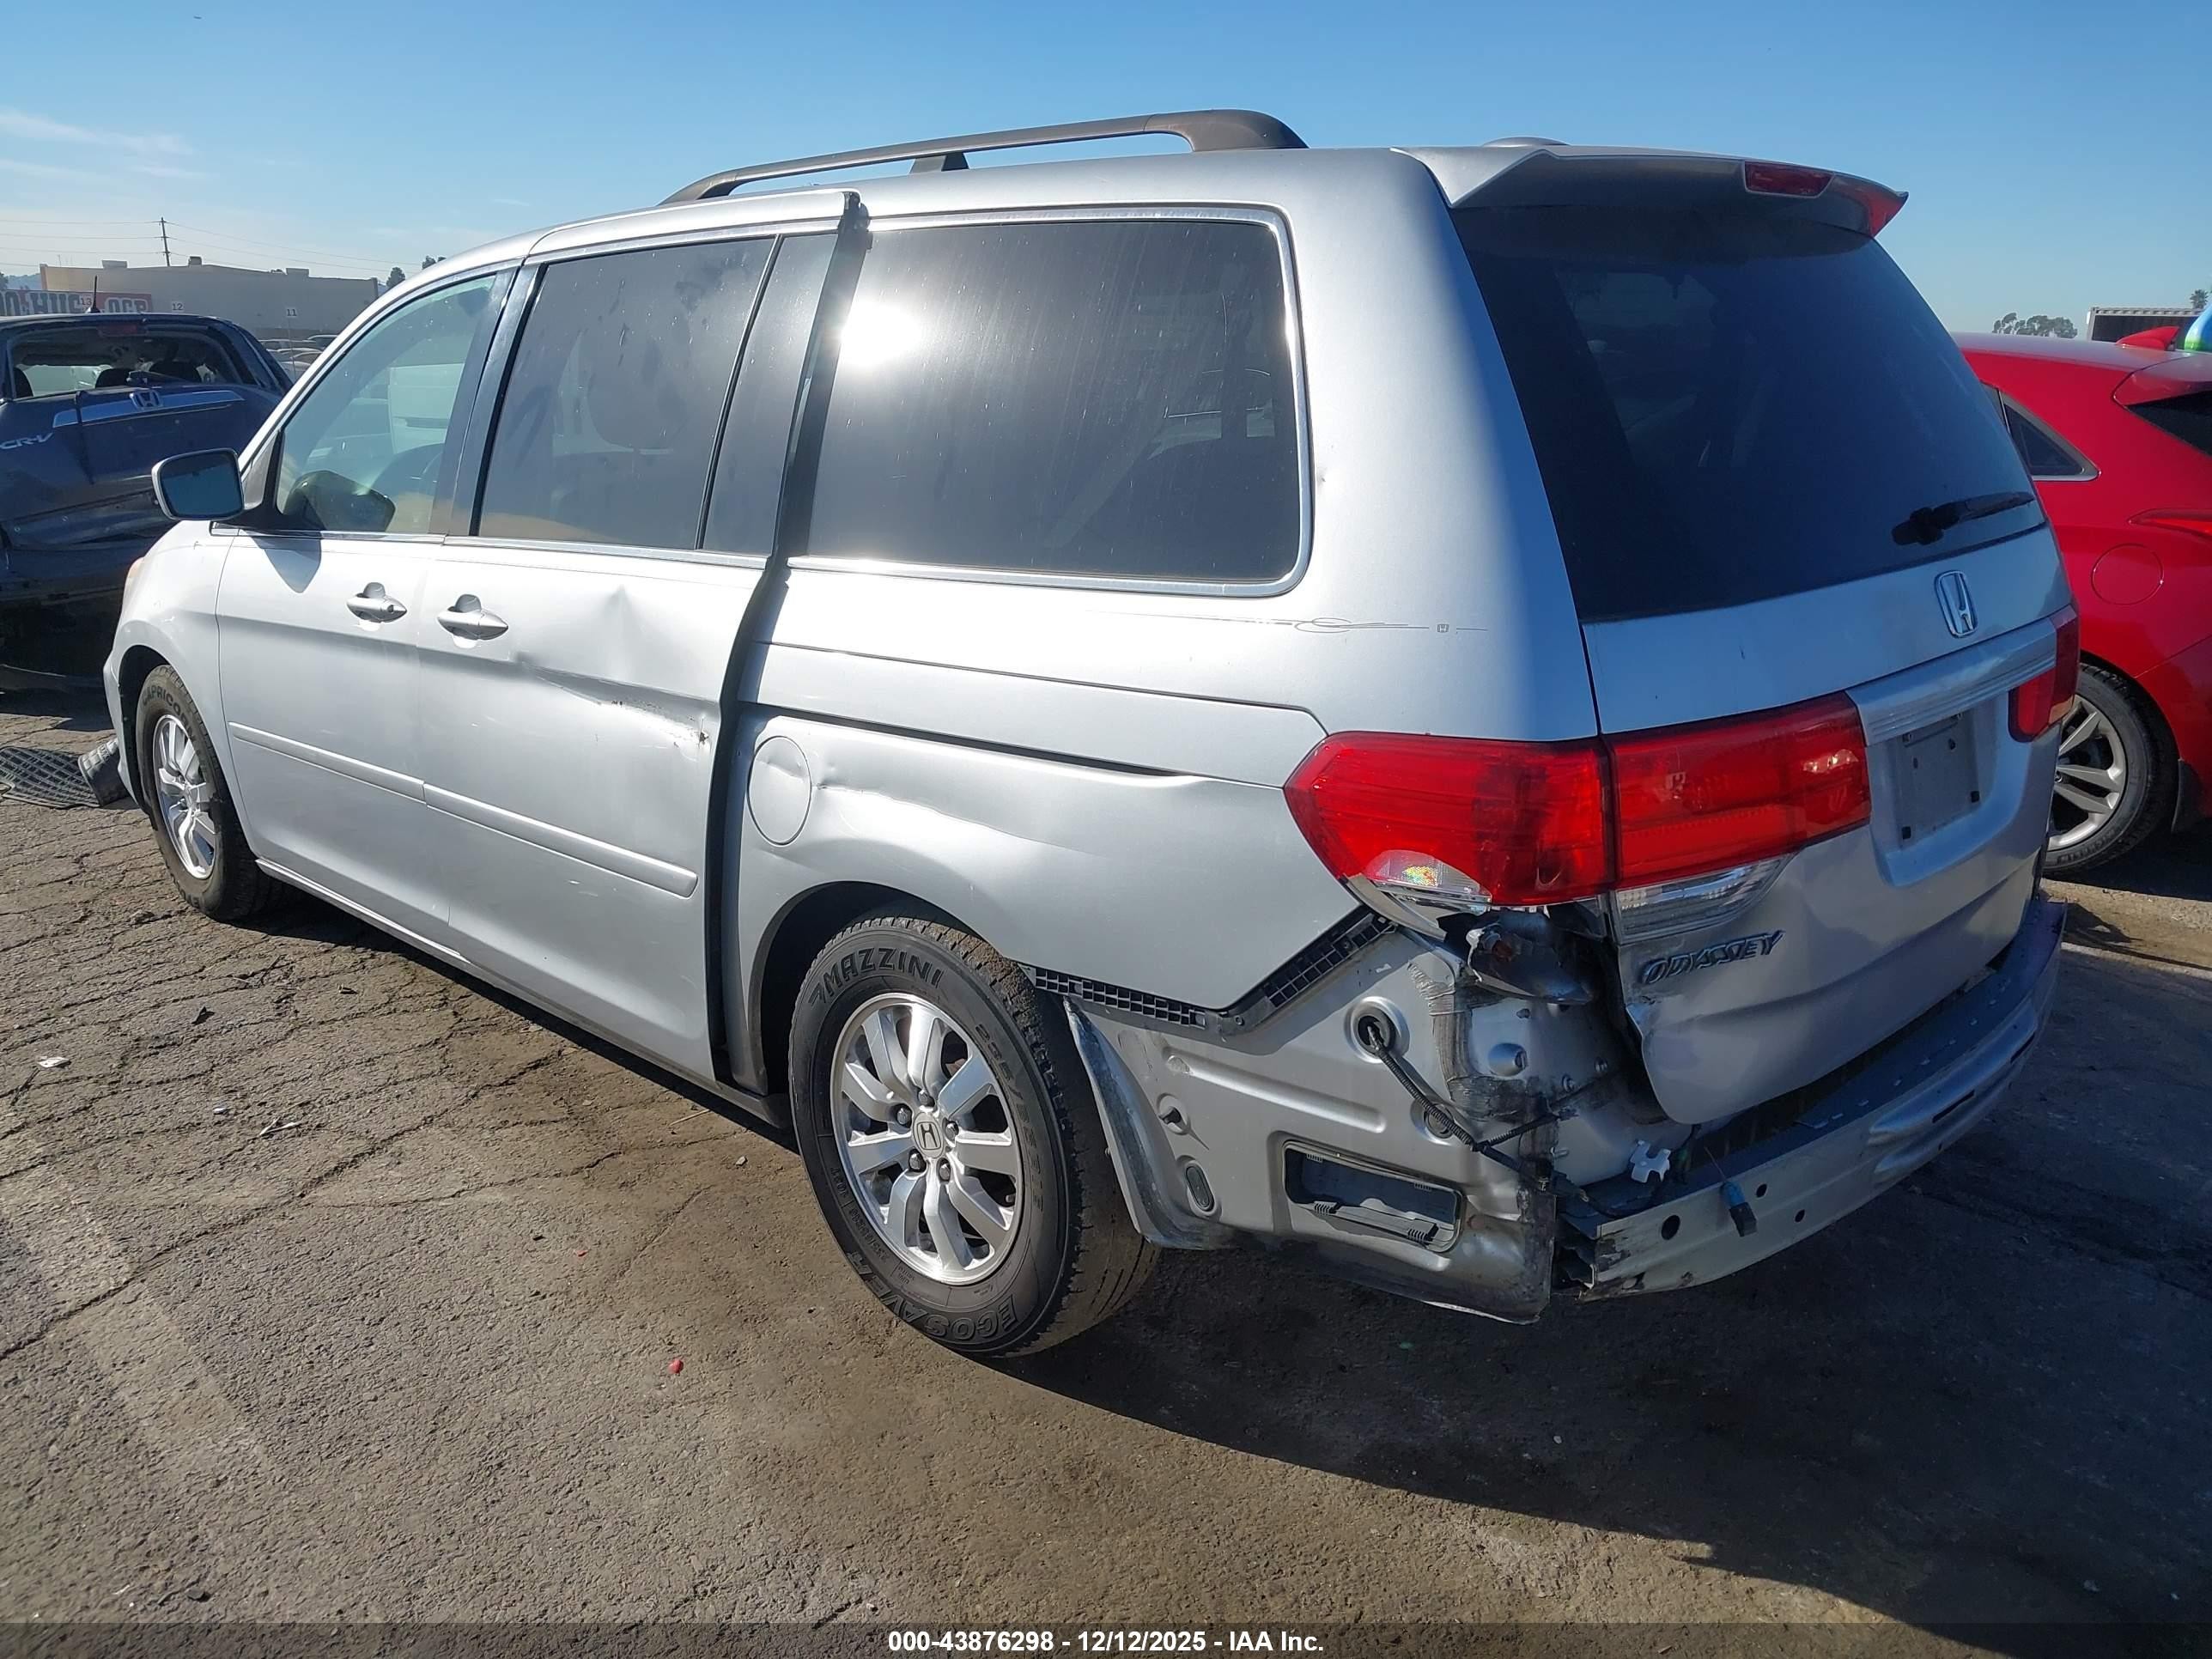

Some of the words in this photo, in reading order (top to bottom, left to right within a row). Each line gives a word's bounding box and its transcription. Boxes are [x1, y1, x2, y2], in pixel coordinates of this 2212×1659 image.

[172, 302, 184, 311] 12
[286, 308, 297, 317] 11
[0, 432, 54, 450] CR-V
[822, 946, 944, 996] MAZZINI
[1639, 929, 1786, 985] ODYSSEY
[846, 1249, 1021, 1343] ECOSAVER
